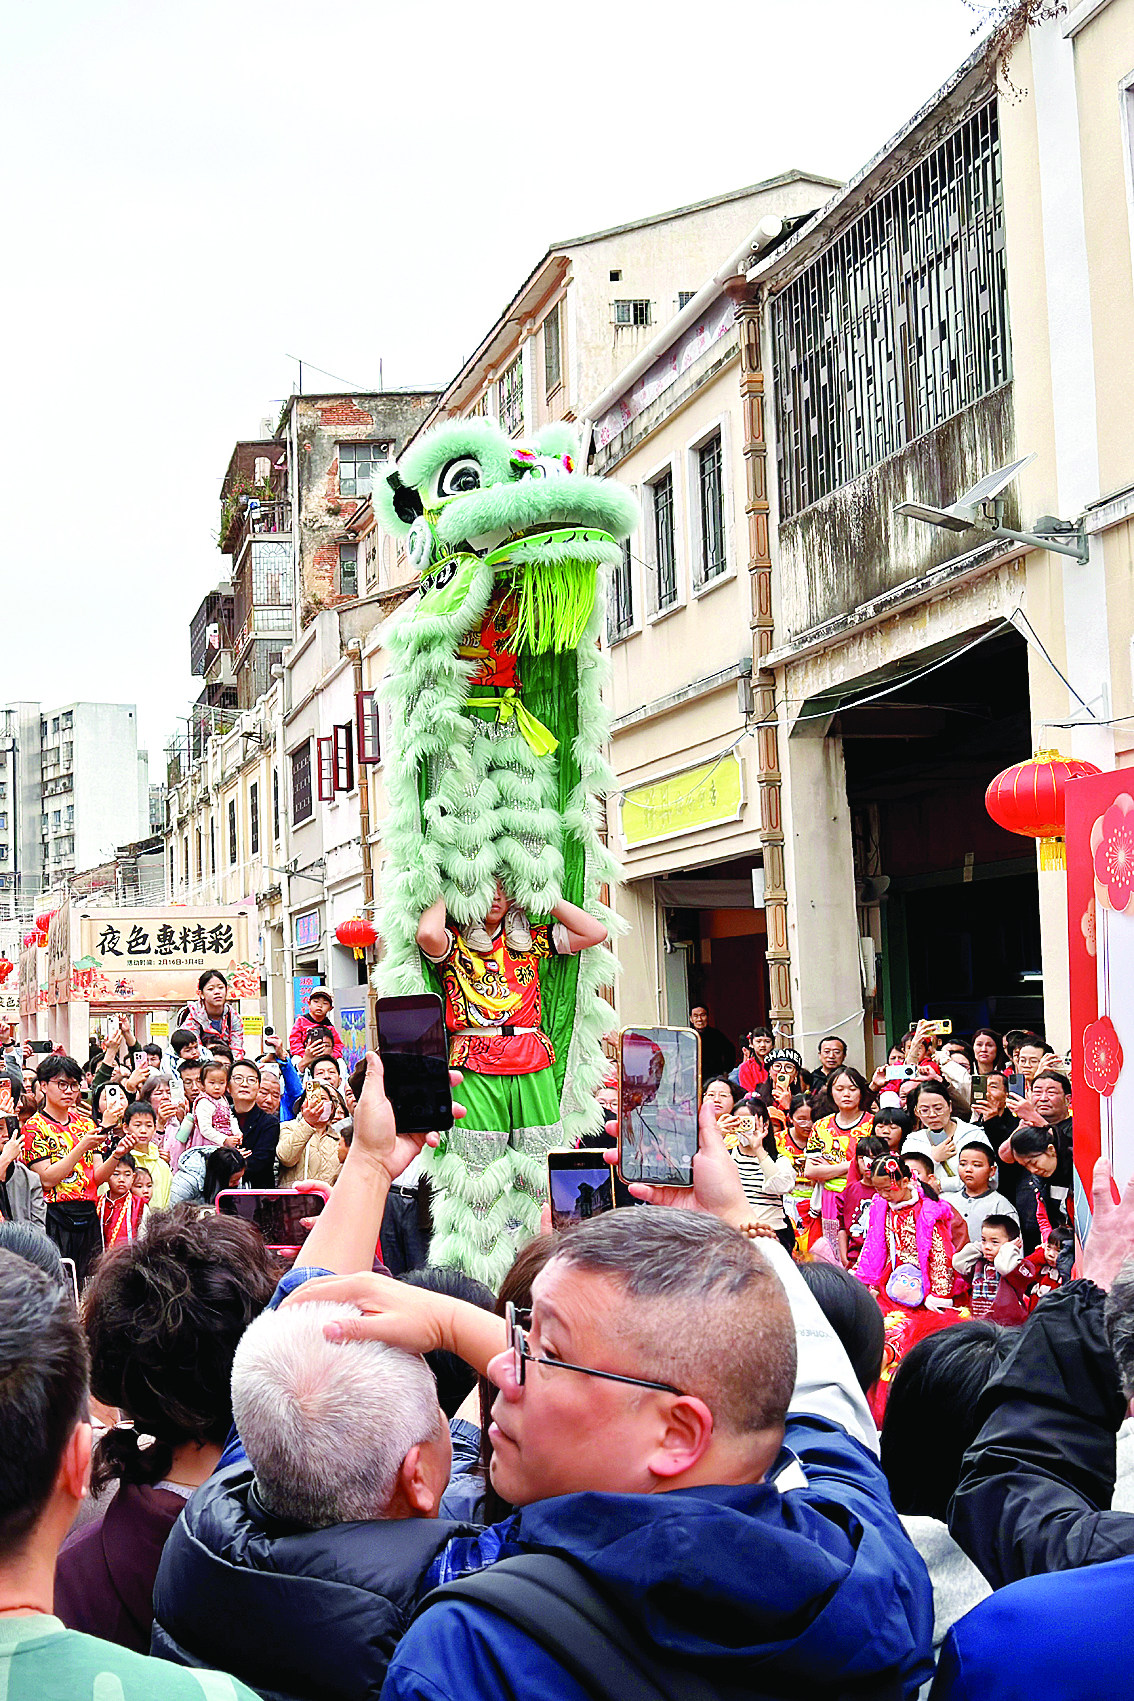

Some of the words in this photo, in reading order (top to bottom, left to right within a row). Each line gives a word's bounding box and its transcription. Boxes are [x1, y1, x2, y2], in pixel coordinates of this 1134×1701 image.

[96, 923, 233, 956] 夜色惠精彩
